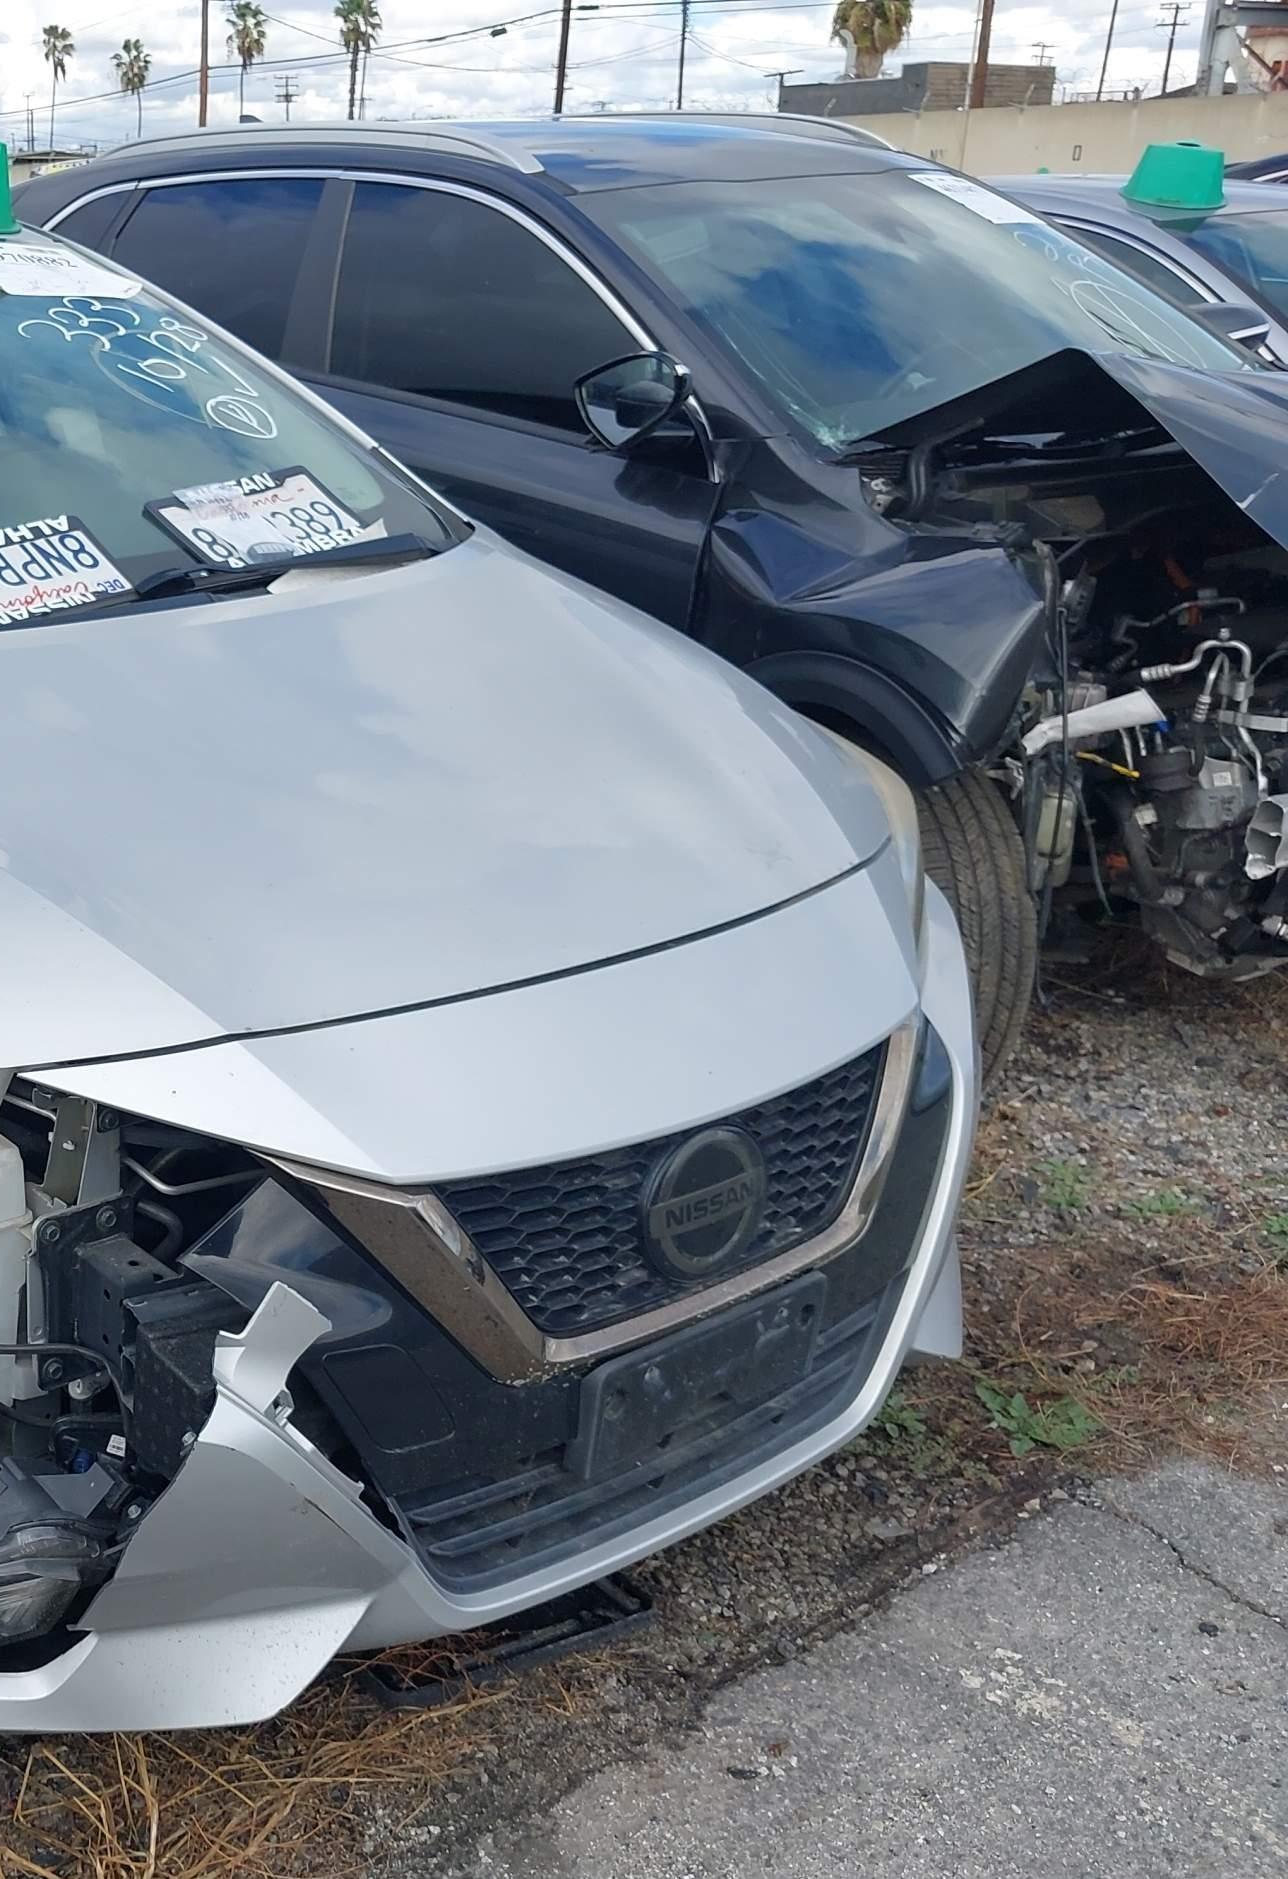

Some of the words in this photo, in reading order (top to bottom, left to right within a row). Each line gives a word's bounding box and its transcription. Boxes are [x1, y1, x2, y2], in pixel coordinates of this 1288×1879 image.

[18, 297, 141, 351] 333
[191, 501, 344, 559] 8389
[665, 1181, 754, 1229] NISSAN
